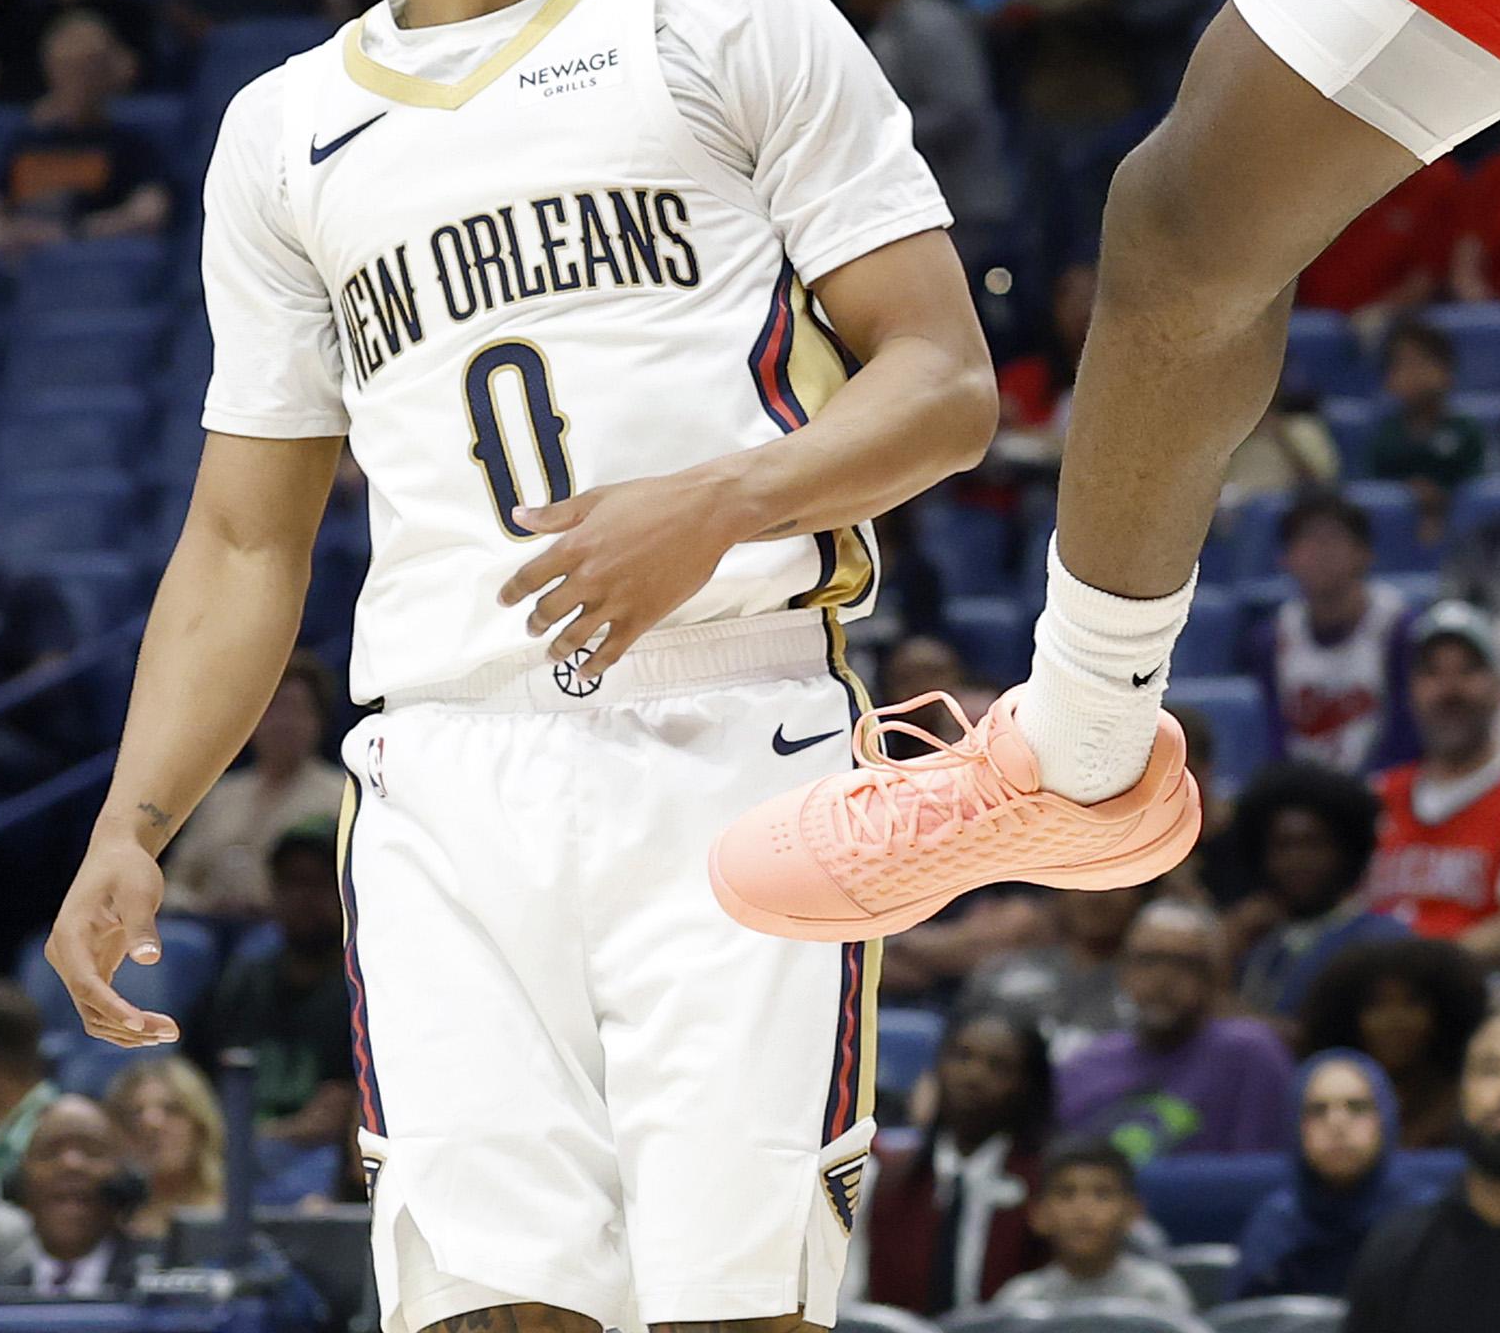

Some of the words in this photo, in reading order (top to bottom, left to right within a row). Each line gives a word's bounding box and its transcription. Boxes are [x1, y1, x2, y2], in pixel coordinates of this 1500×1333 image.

[519, 48, 619, 89] NEWAGE
[543, 77, 597, 98] GRILLS
[338, 243, 425, 391] NEW
[430, 187, 701, 323] ORLEANS
[461, 336, 576, 543] 0
